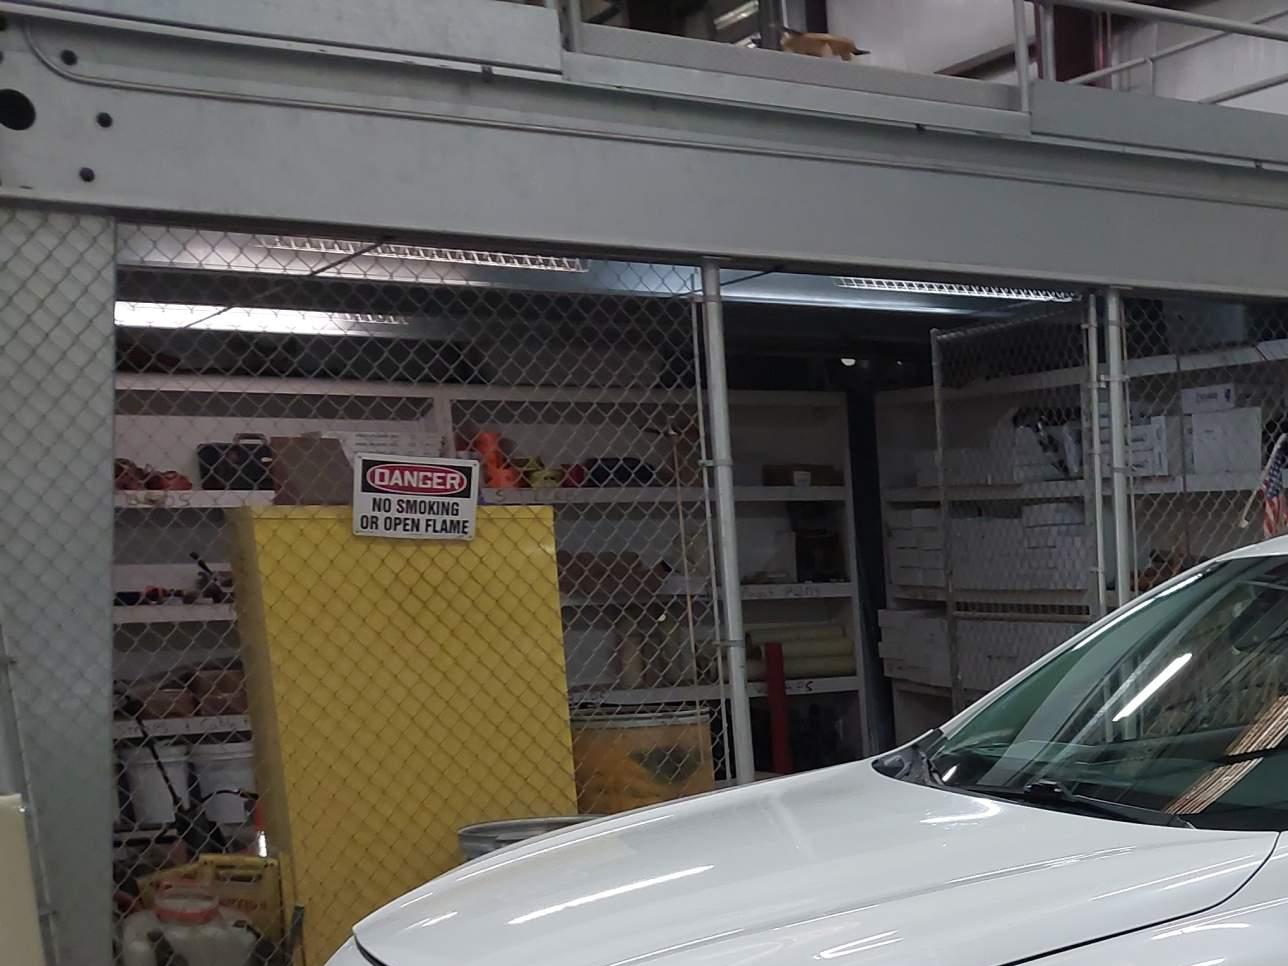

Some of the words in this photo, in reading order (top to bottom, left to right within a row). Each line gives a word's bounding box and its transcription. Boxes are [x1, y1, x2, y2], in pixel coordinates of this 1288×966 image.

[373, 468, 460, 490] DANGER
[372, 497, 392, 513] NO
[396, 499, 460, 516] SMOKING
[360, 515, 379, 531] OR
[384, 516, 420, 533] OPEN
[425, 518, 469, 535] FLAME
